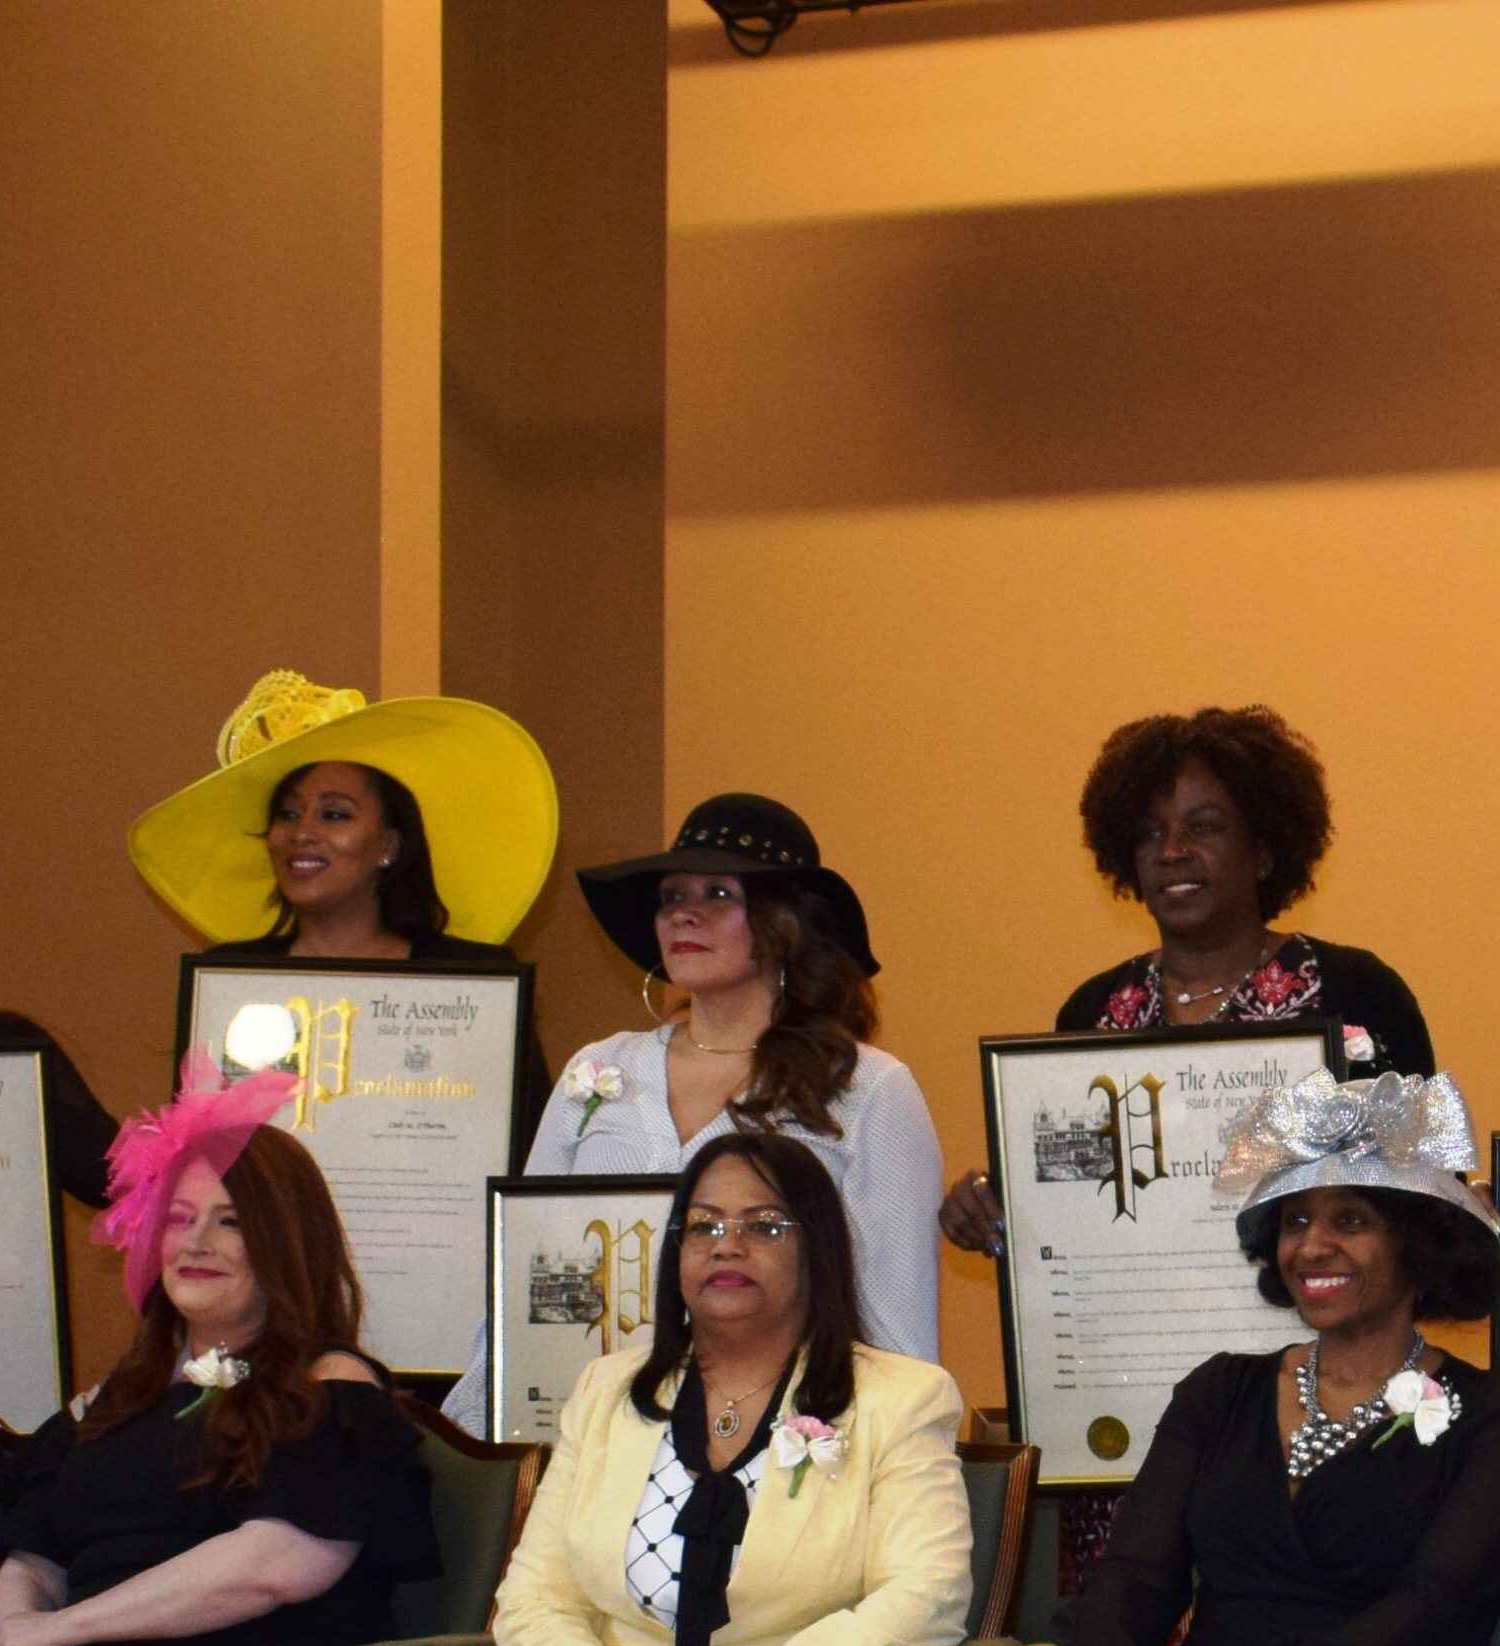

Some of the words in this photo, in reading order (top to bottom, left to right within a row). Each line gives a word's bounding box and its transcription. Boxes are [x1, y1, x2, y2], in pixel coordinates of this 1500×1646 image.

[372, 994, 398, 1019] The
[405, 997, 479, 1030] Assembly
[1177, 1064, 1206, 1092] The
[1213, 1059, 1288, 1089] Assembly
